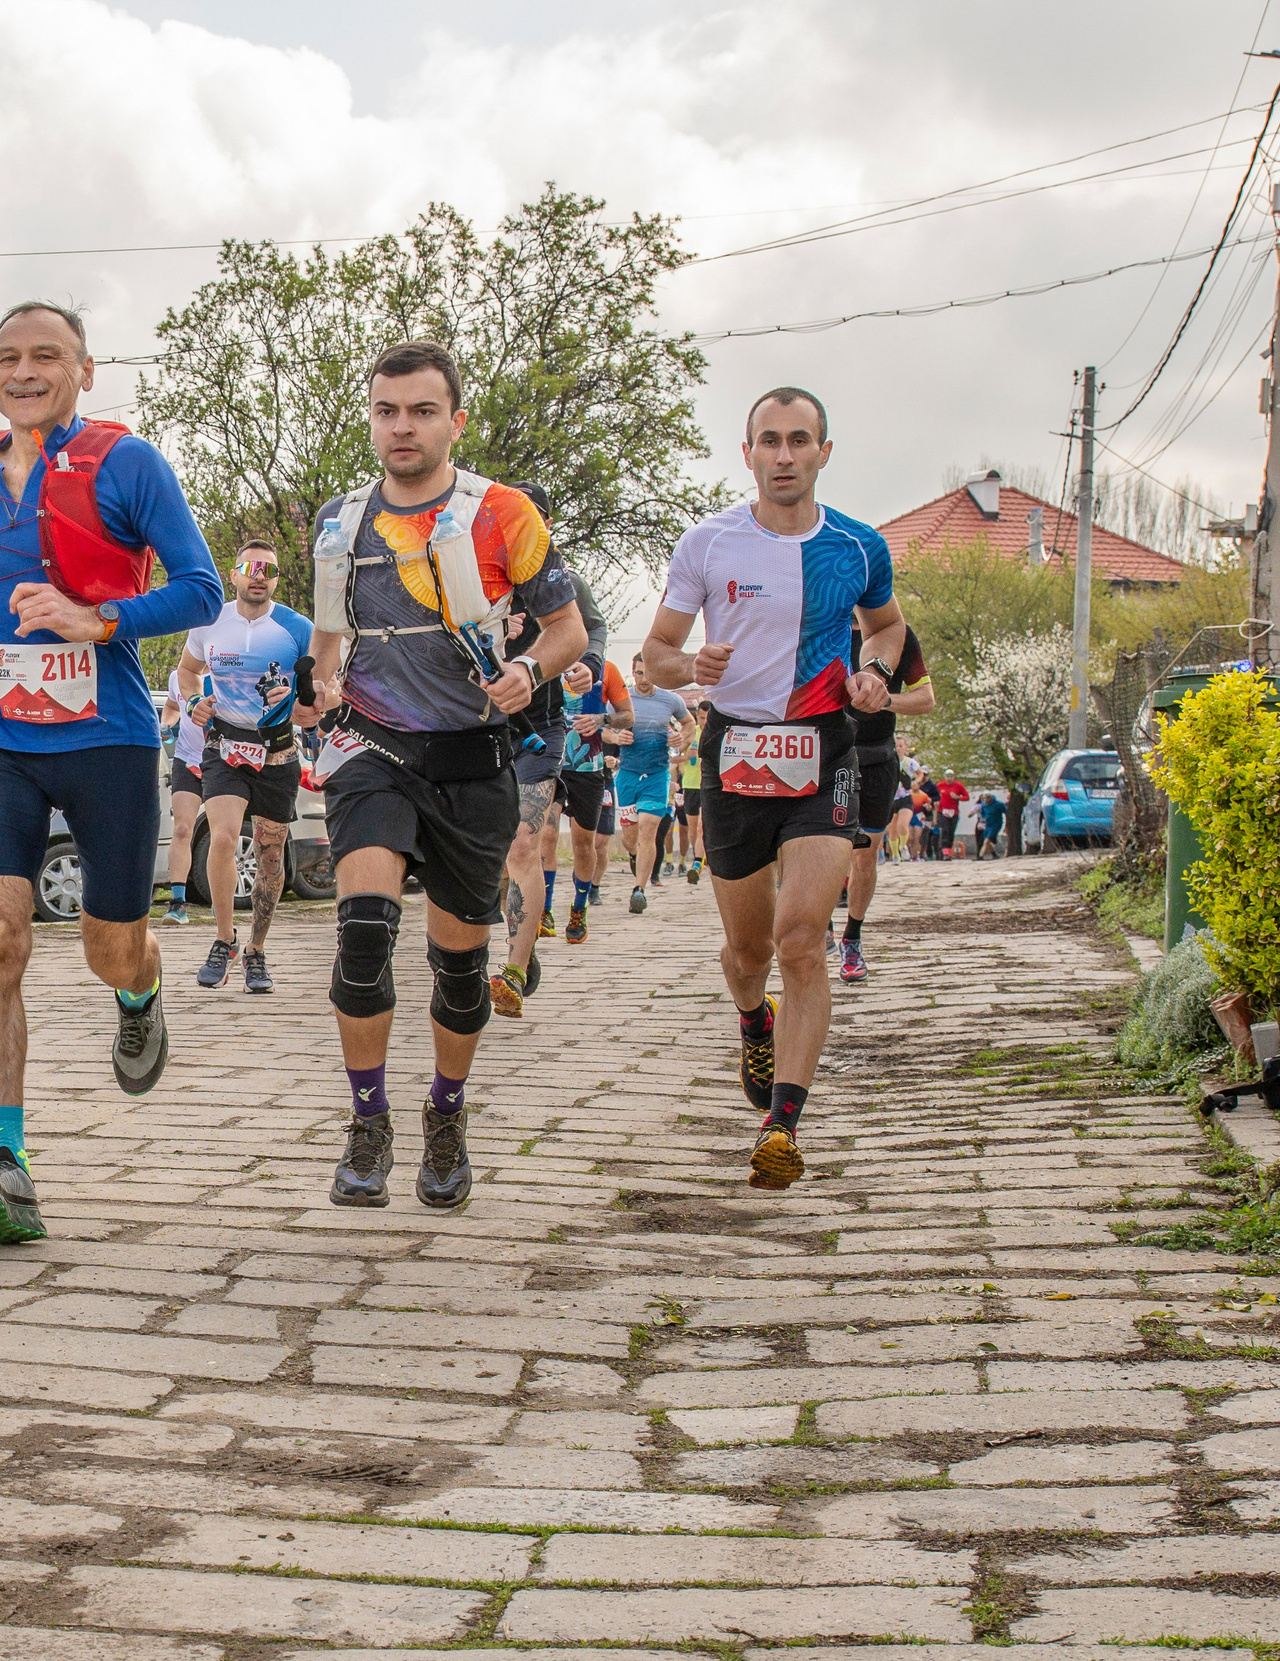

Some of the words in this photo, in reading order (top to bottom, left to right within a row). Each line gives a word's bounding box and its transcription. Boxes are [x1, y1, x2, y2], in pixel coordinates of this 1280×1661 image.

[41, 649, 92, 681] 2114
[724, 747, 736, 755] 22K
[755, 735, 813, 759] 2360
